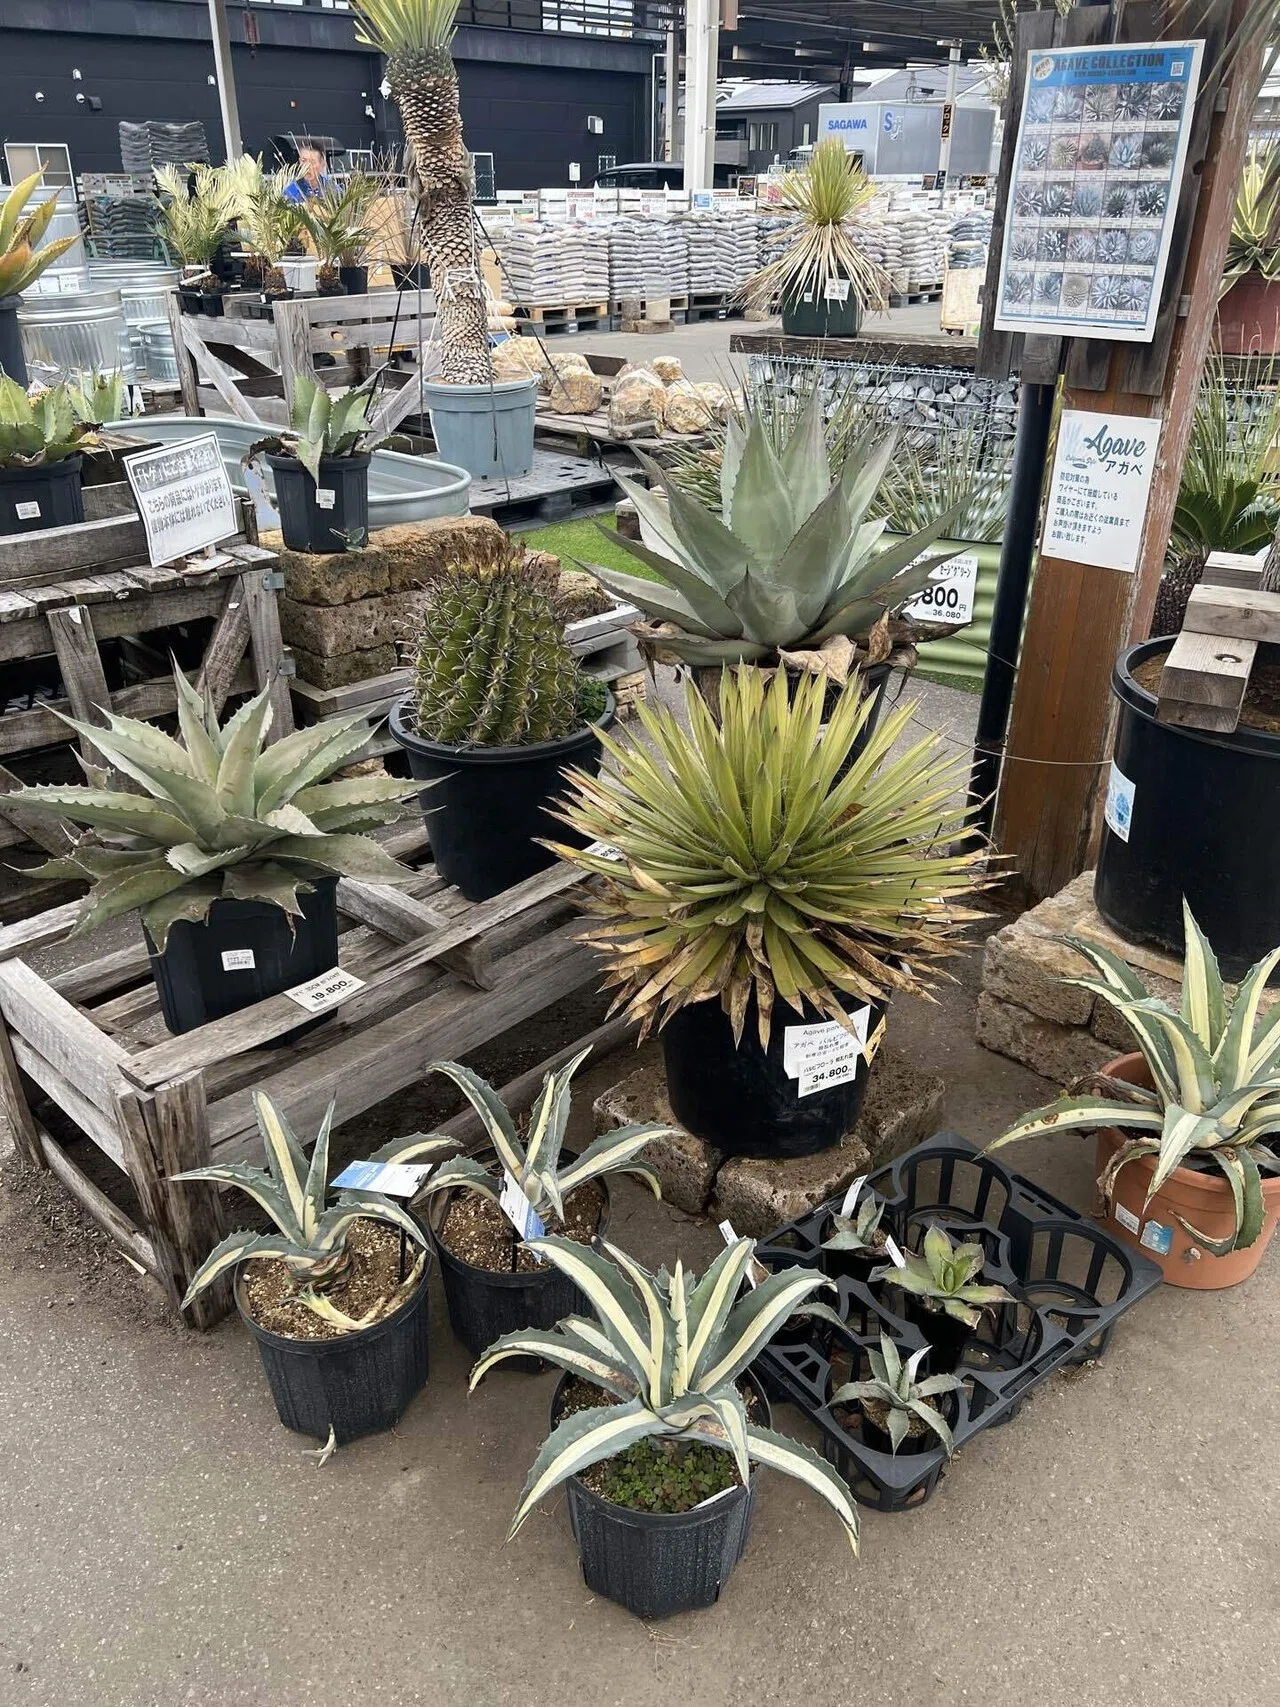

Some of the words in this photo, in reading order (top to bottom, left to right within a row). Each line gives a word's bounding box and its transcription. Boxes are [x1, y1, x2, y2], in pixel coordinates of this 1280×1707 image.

[1055, 56, 1089, 72] AGAVE
[1091, 53, 1165, 69] COLLECTION
[828, 119, 868, 130] SAGAWA
[1083, 424, 1147, 462] Agave
[1104, 459, 1143, 476] アガベ
